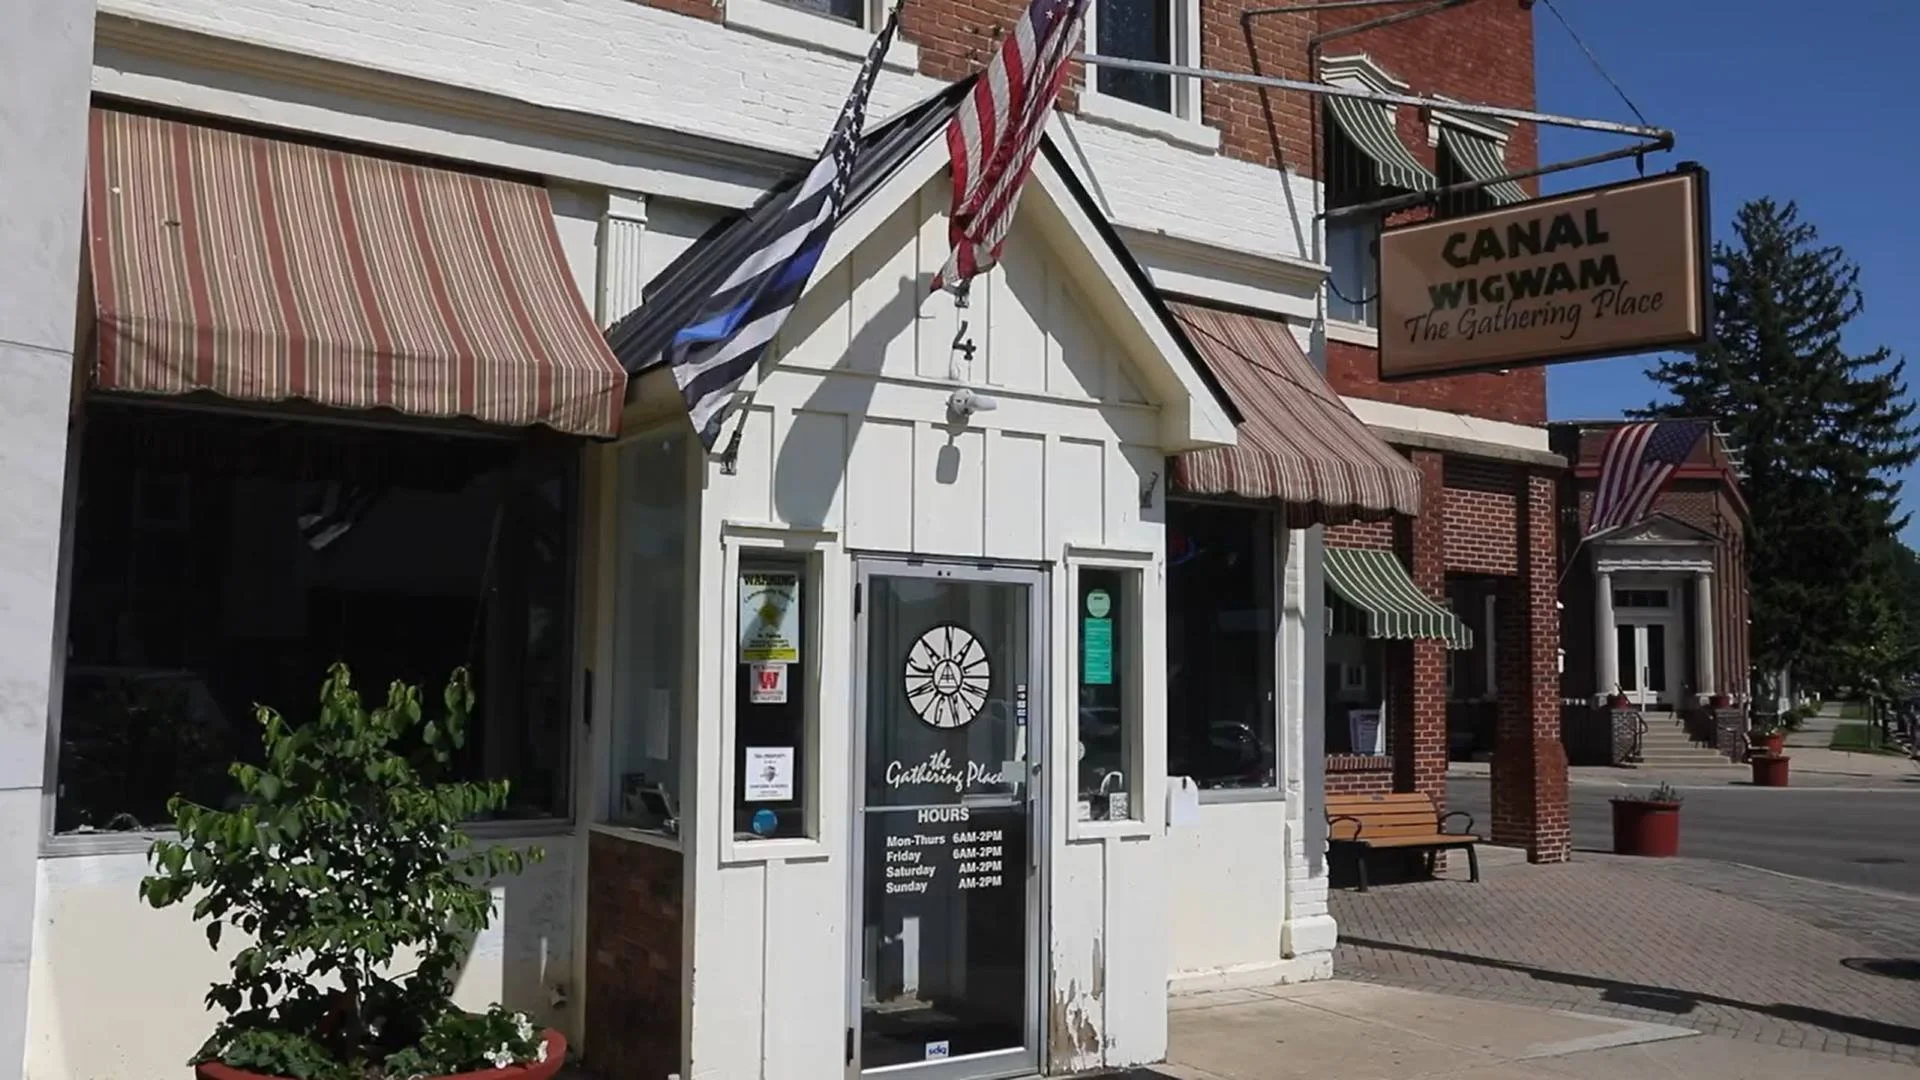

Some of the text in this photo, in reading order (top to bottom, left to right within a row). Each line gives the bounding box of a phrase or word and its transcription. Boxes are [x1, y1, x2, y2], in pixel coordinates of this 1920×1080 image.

[1441, 207, 1609, 268] CANAL
[1428, 254, 1622, 312] WIGWAM
[1404, 280, 1664, 343] The Gathering Place
[929, 749, 952, 770] the
[886, 760, 964, 792] Gathering
[917, 807, 970, 824] HOURS
[886, 830, 1003, 847] Mon-Thurs 6AM-2PM
[886, 846, 1003, 863] Friday 6AM-2PM
[886, 860, 1003, 878] Saturday AM-2PM
[886, 875, 1003, 894] Sunday AM-2PM
